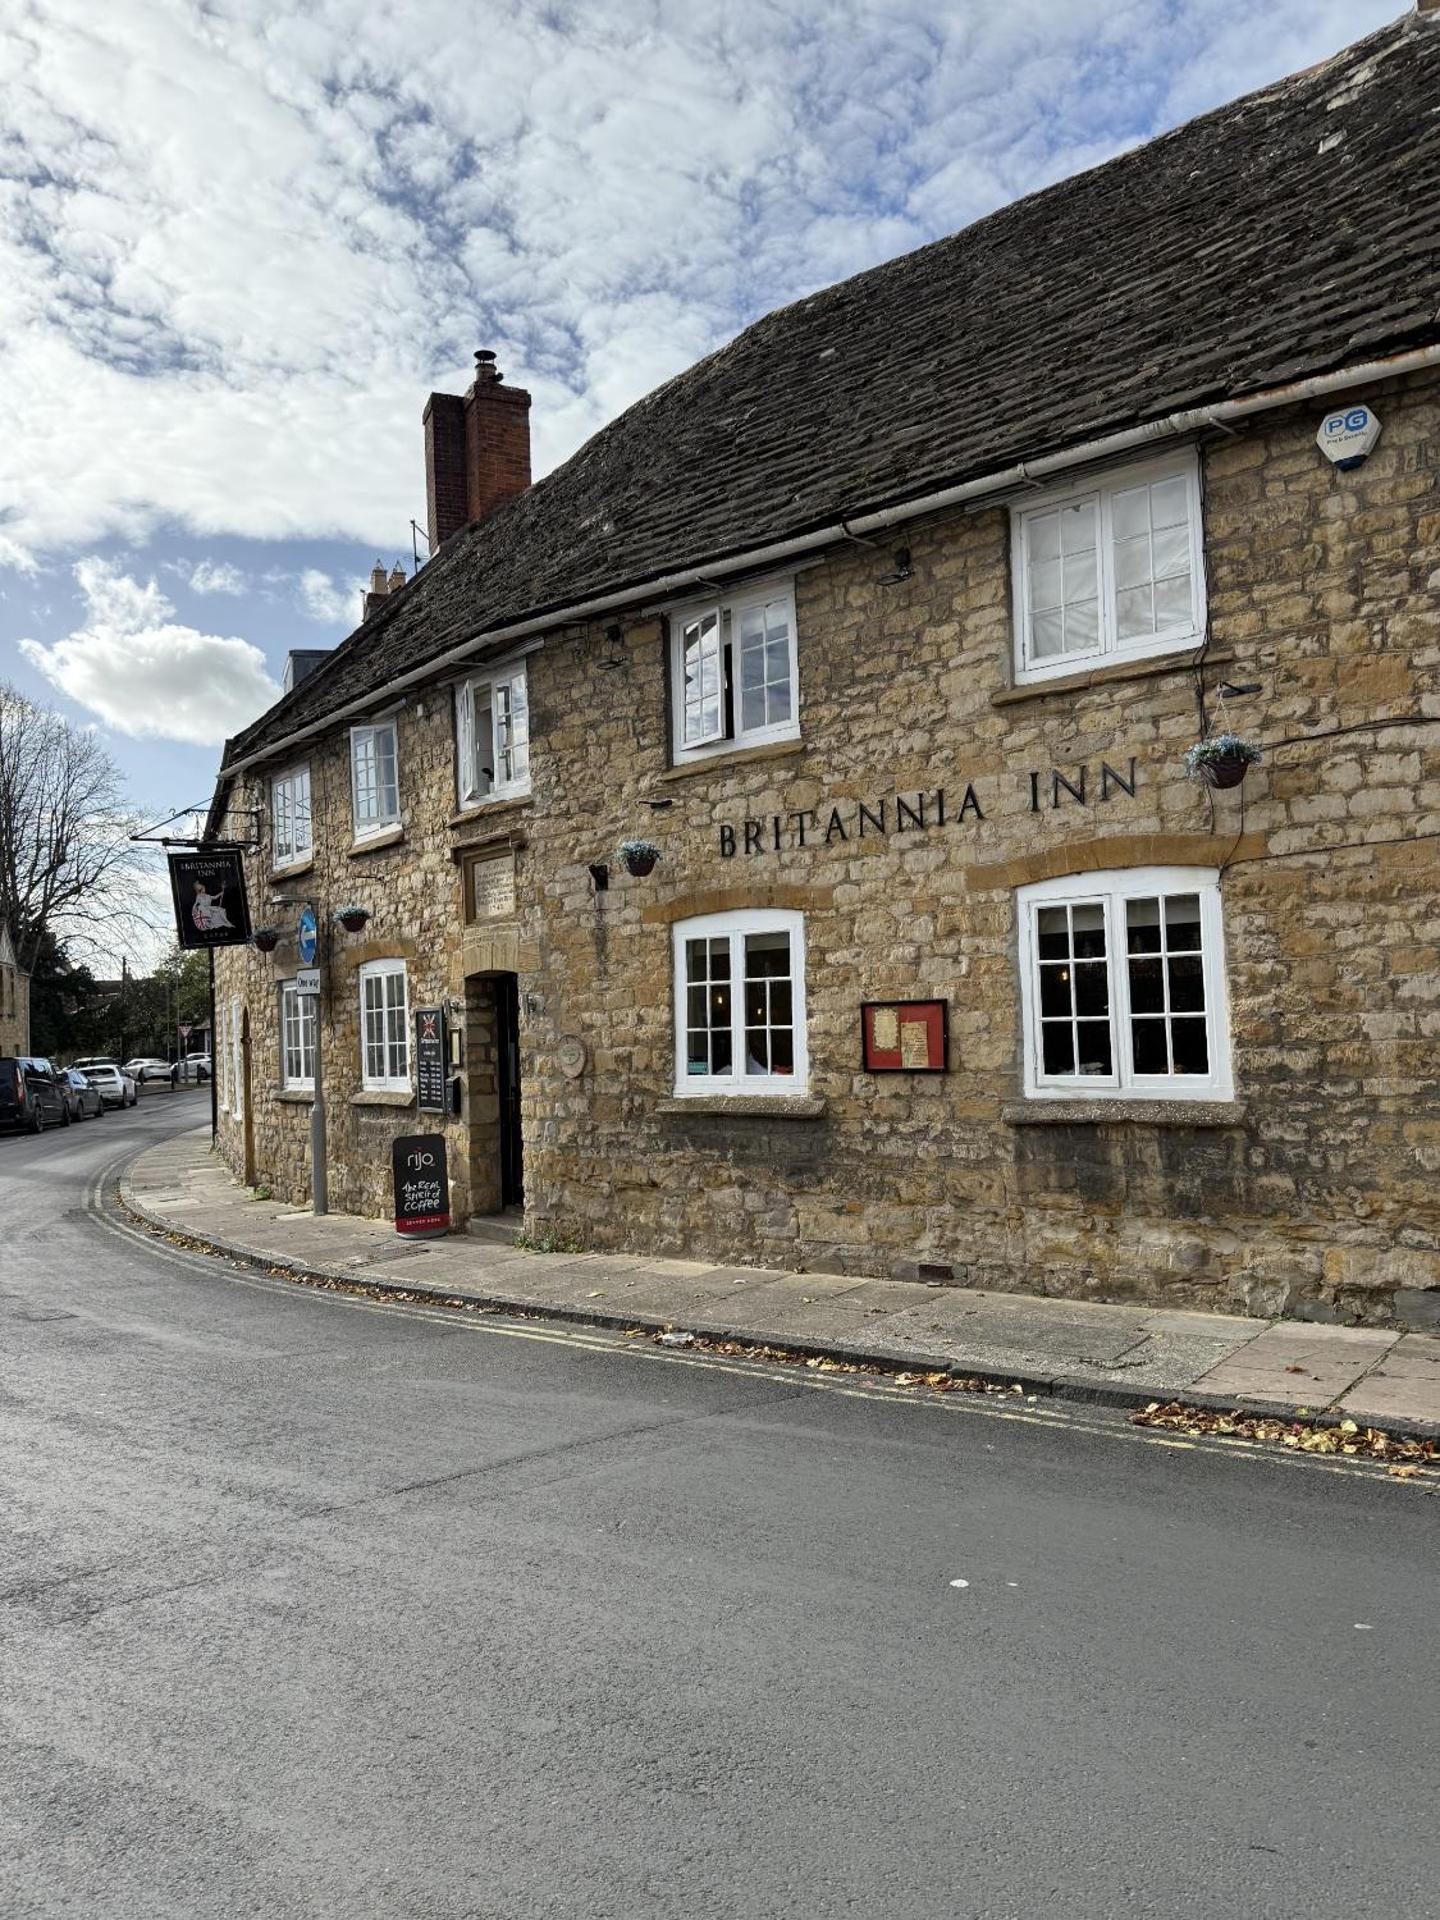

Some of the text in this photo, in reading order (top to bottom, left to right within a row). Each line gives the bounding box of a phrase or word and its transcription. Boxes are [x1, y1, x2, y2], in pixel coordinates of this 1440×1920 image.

[1328, 411, 1365, 434] PG
[719, 756, 1137, 858] BRITANNIA INN
[181, 860, 231, 870] BRITANNIA
[197, 869, 216, 878] INN
[297, 977, 319, 989] One way
[408, 1150, 433, 1171] rijo
